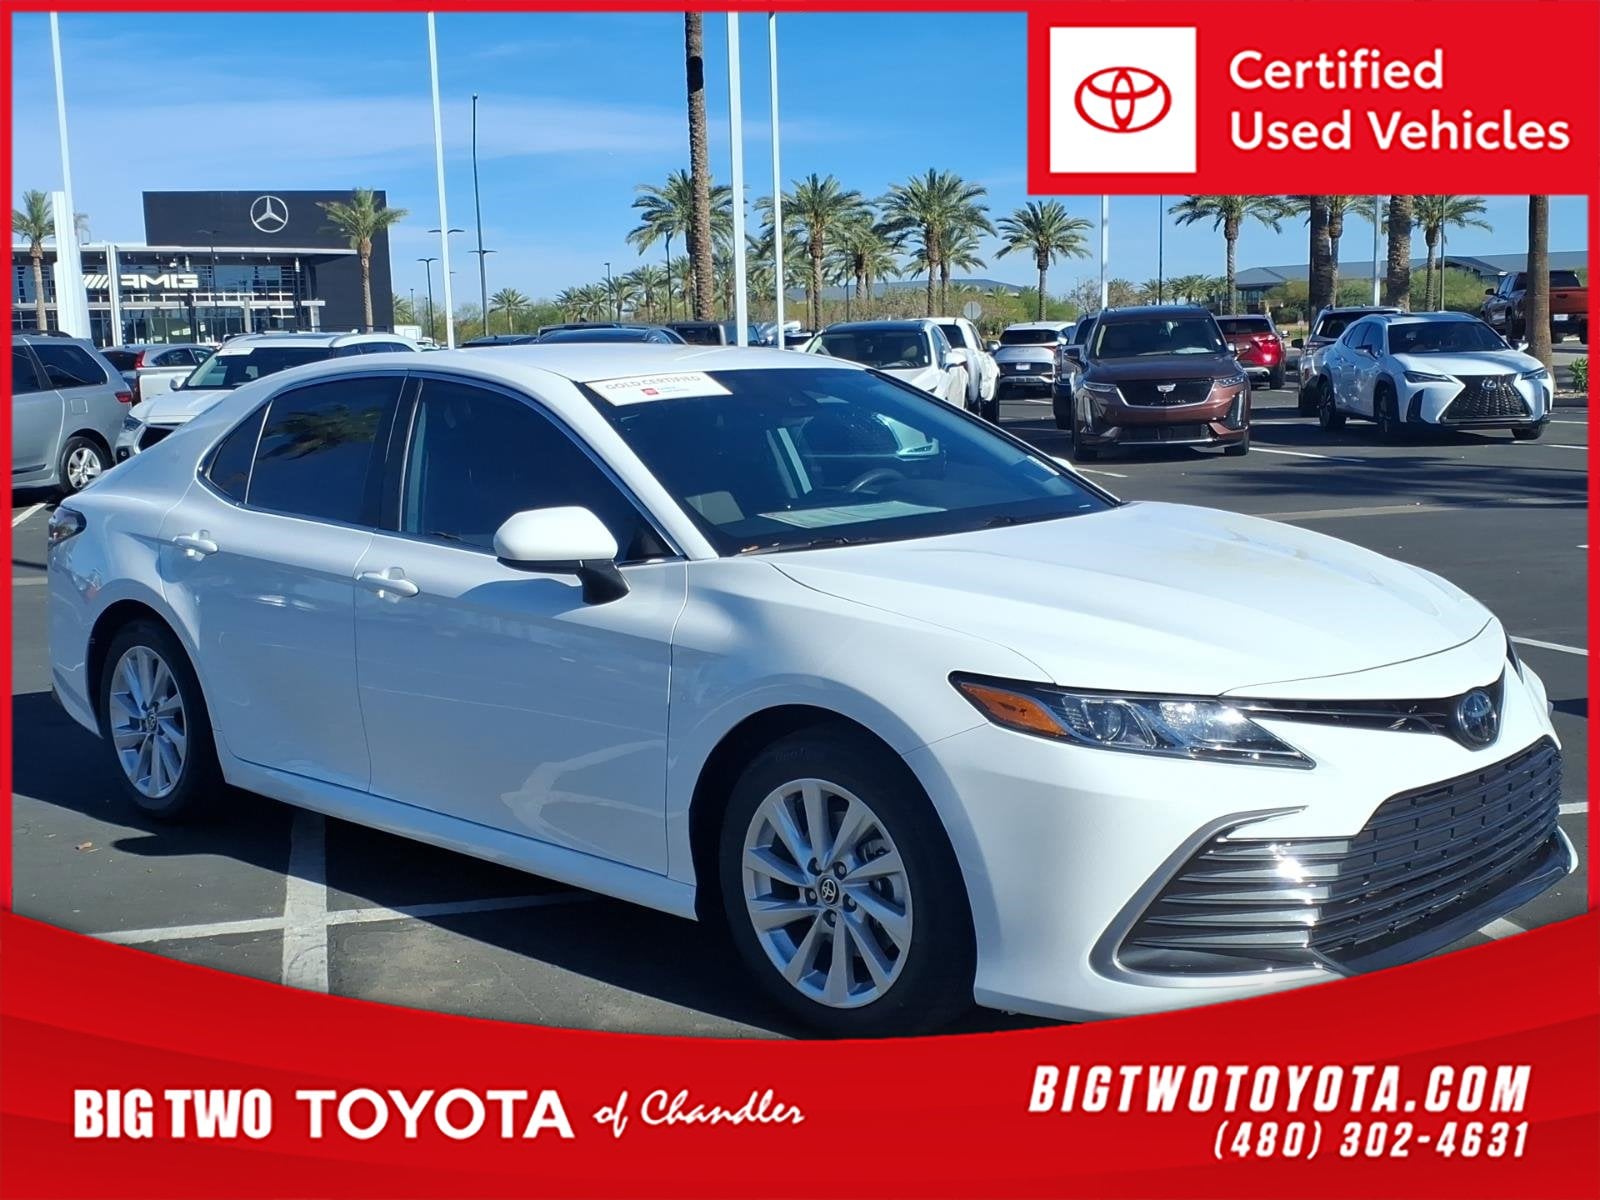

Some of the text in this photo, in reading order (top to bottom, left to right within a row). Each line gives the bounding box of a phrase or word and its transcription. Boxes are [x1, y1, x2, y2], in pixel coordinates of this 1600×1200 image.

[120, 274, 199, 288] AMG
[604, 375, 701, 390] GOLD CERTIFIED
